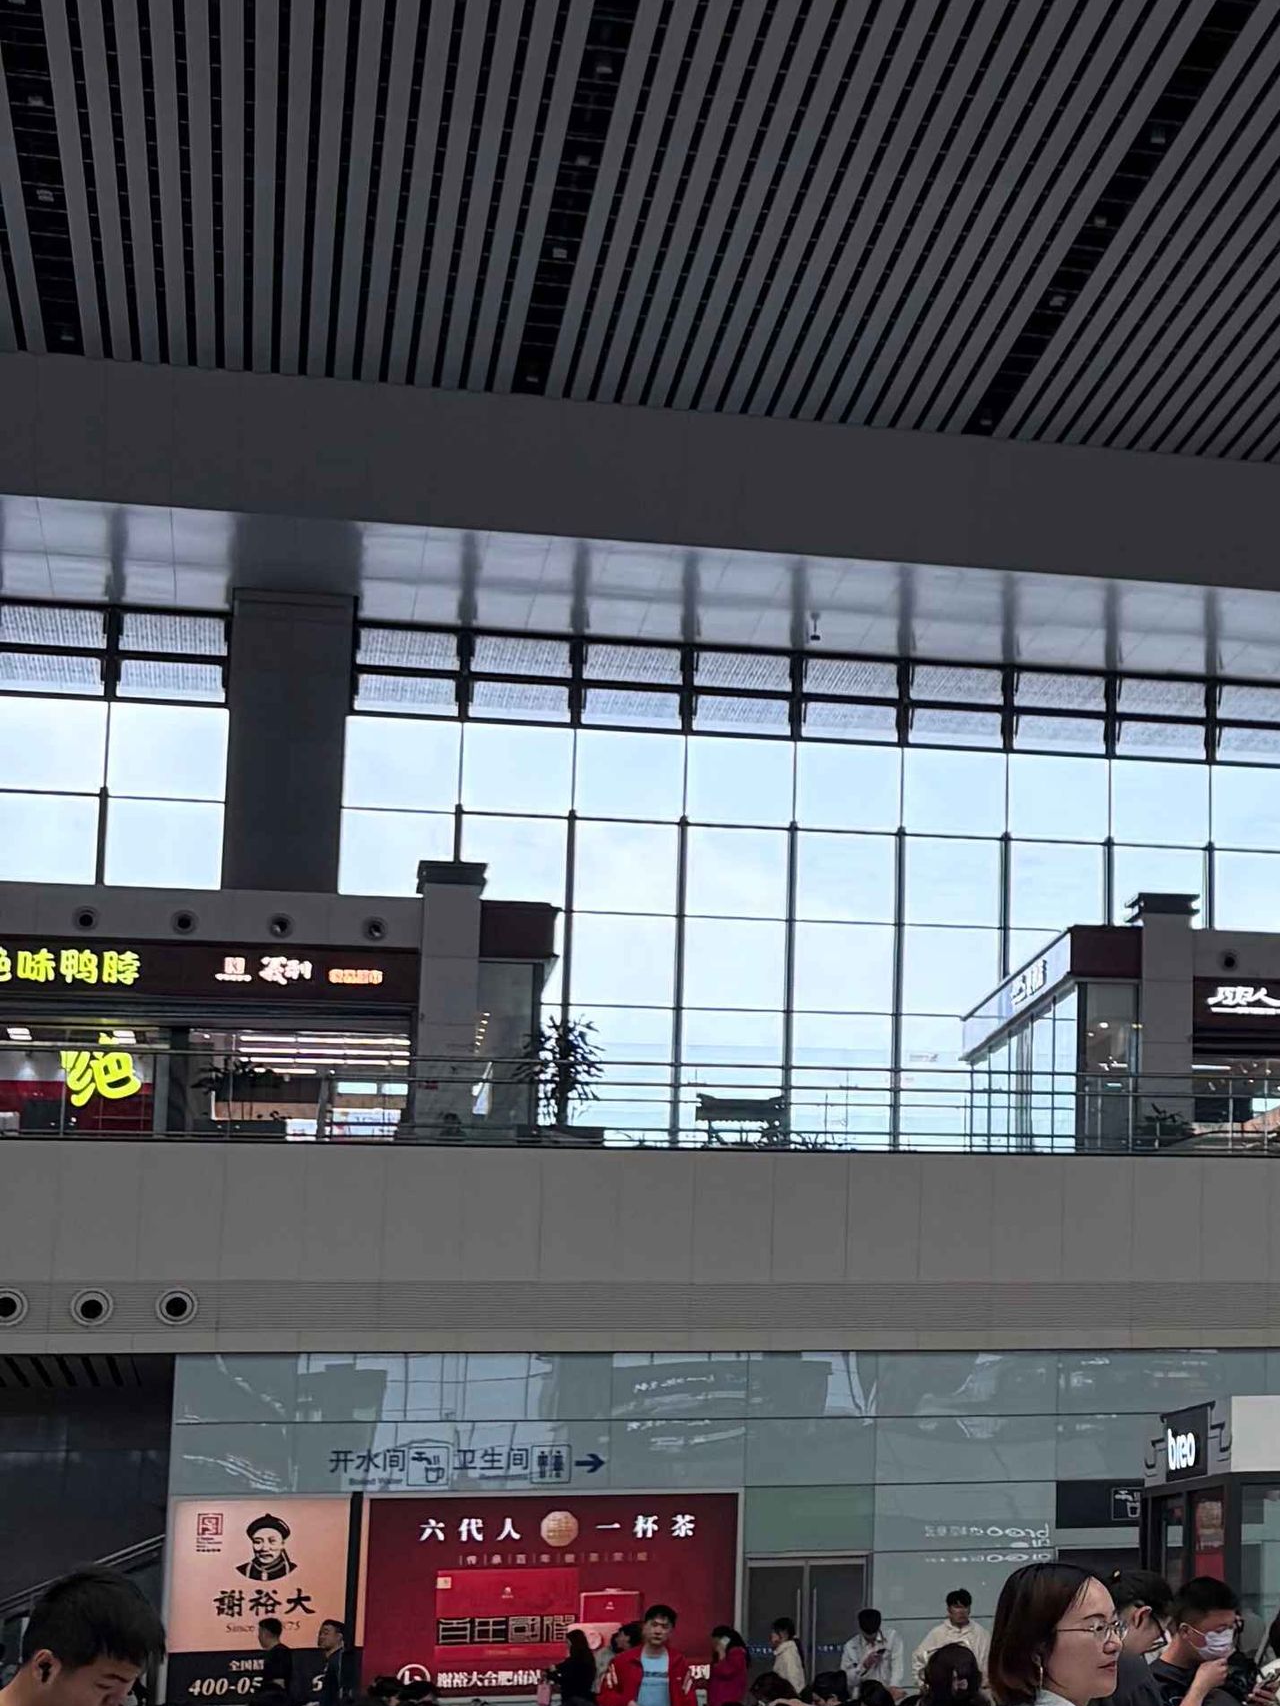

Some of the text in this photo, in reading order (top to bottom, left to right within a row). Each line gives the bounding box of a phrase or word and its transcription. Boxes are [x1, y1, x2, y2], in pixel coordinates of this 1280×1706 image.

[329, 1446, 529, 1474] 开水间 卫生间
[1167, 1428, 1196, 1470] breo
[419, 1514, 696, 1542] 六代人 一杯茶
[213, 1588, 316, 1618] 謝裕大
